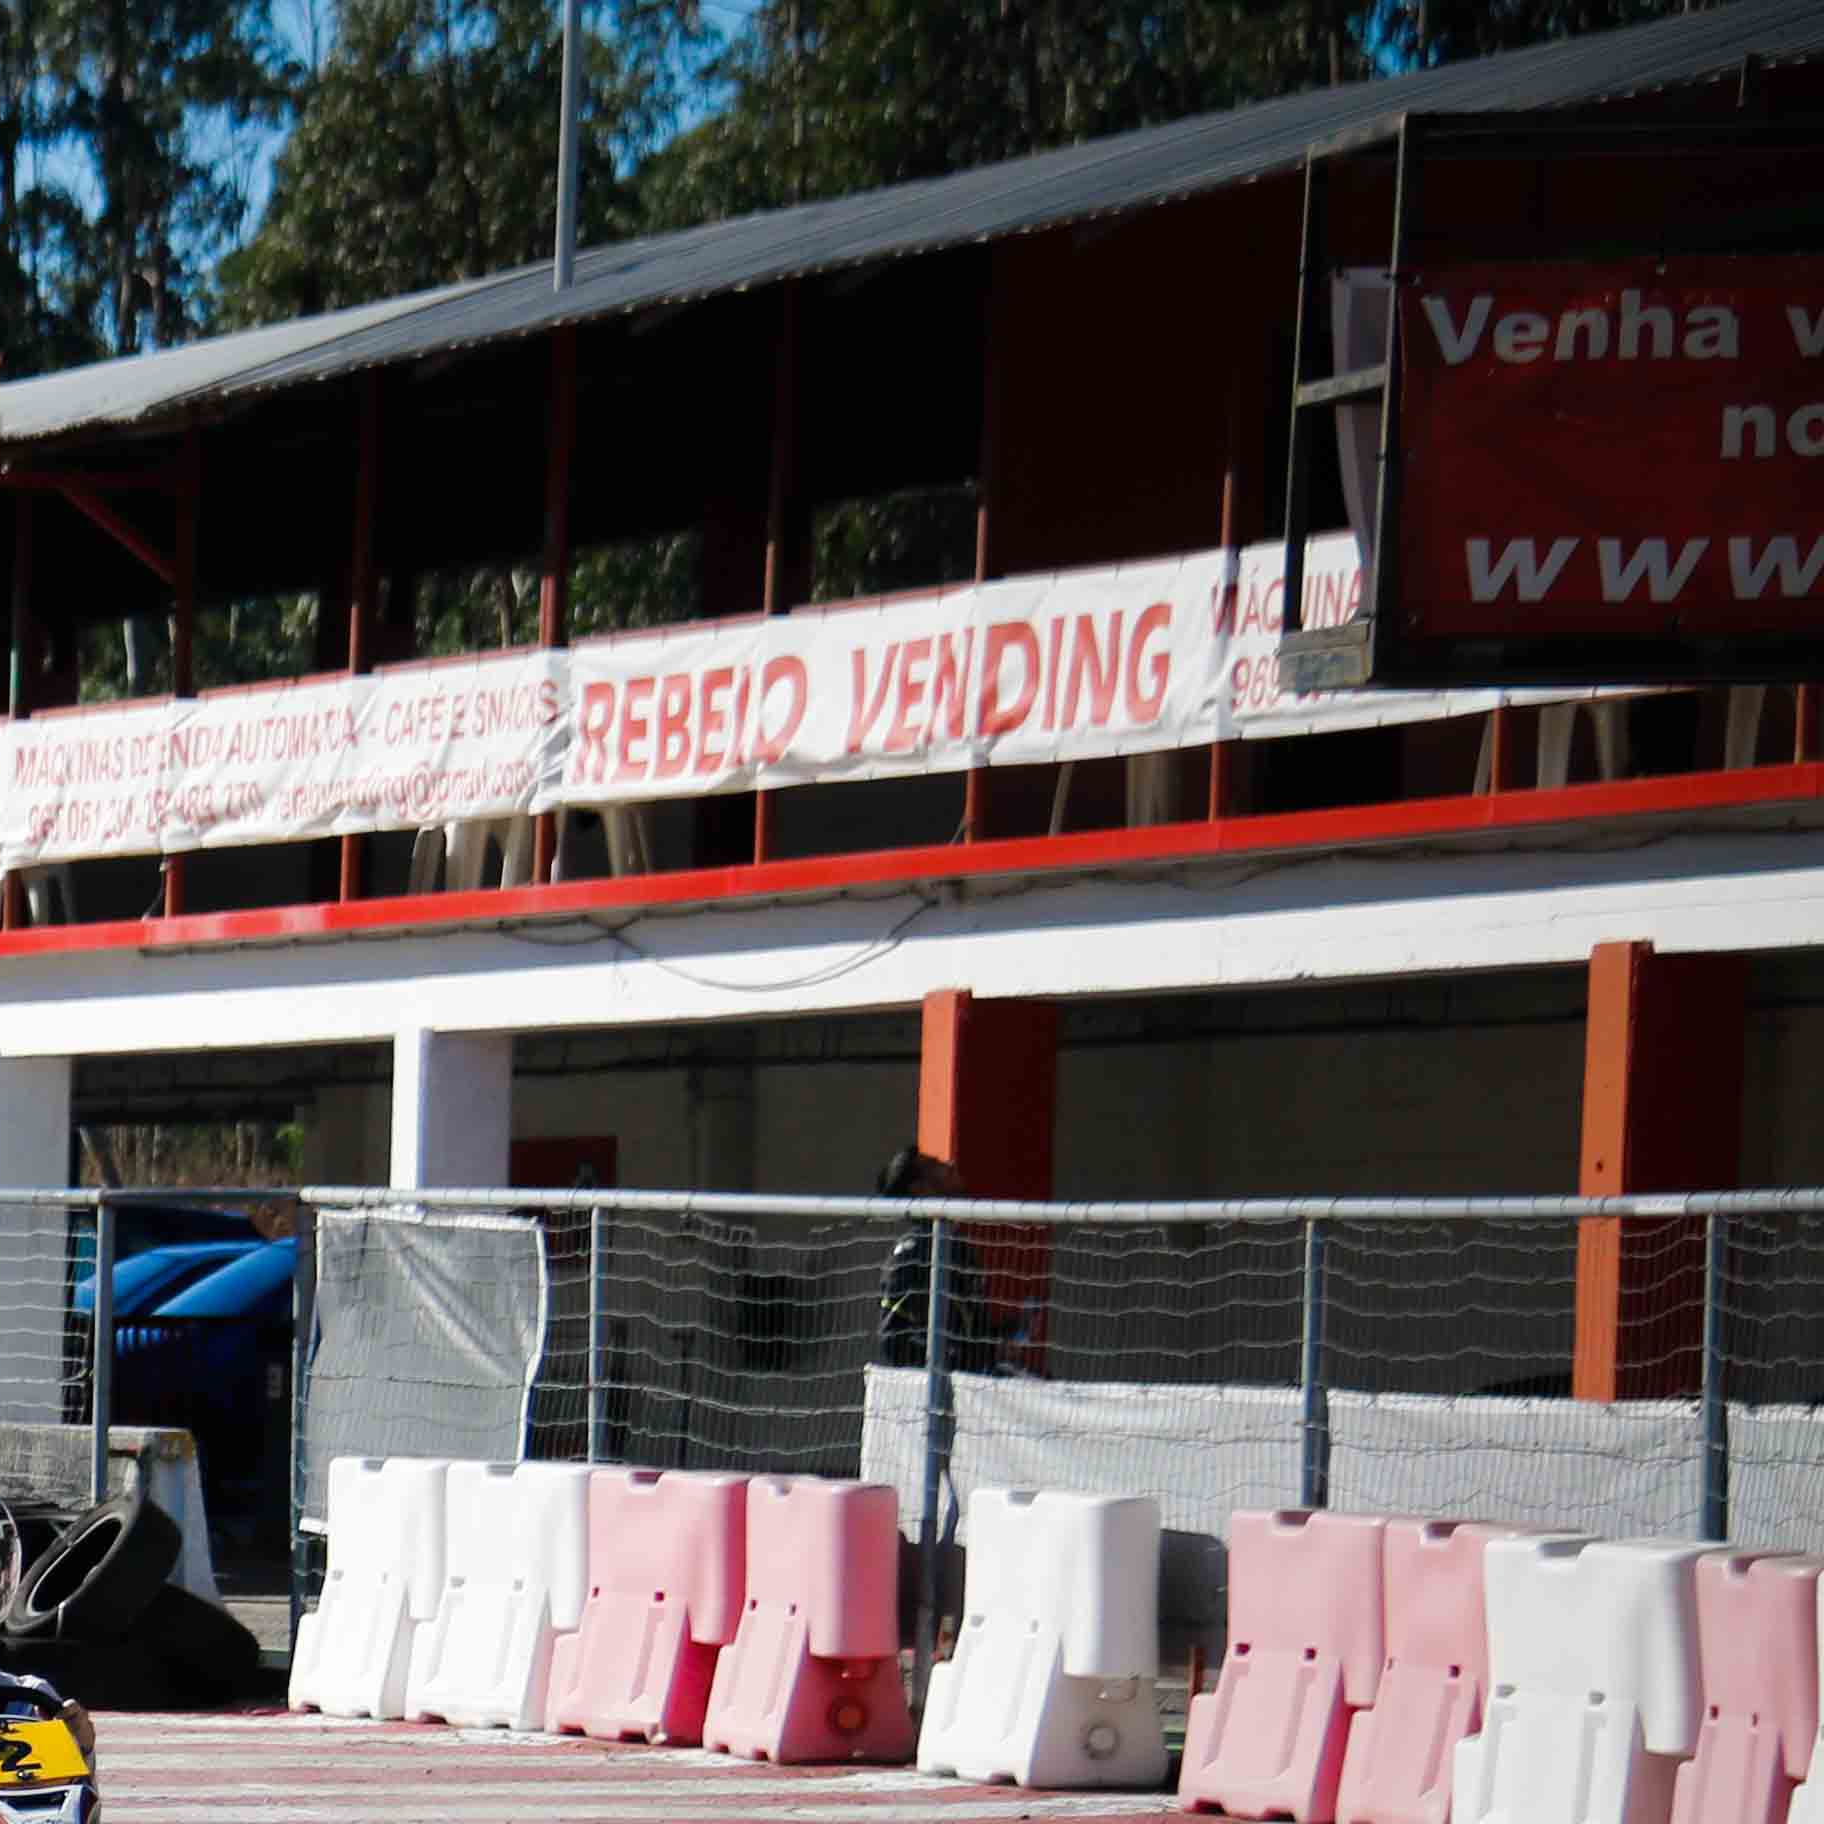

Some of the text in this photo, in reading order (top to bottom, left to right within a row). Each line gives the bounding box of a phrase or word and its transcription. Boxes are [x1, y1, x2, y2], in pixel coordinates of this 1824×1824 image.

[1421, 289, 1740, 366] Venha
[575, 602, 1172, 784] REBELO VENDING
